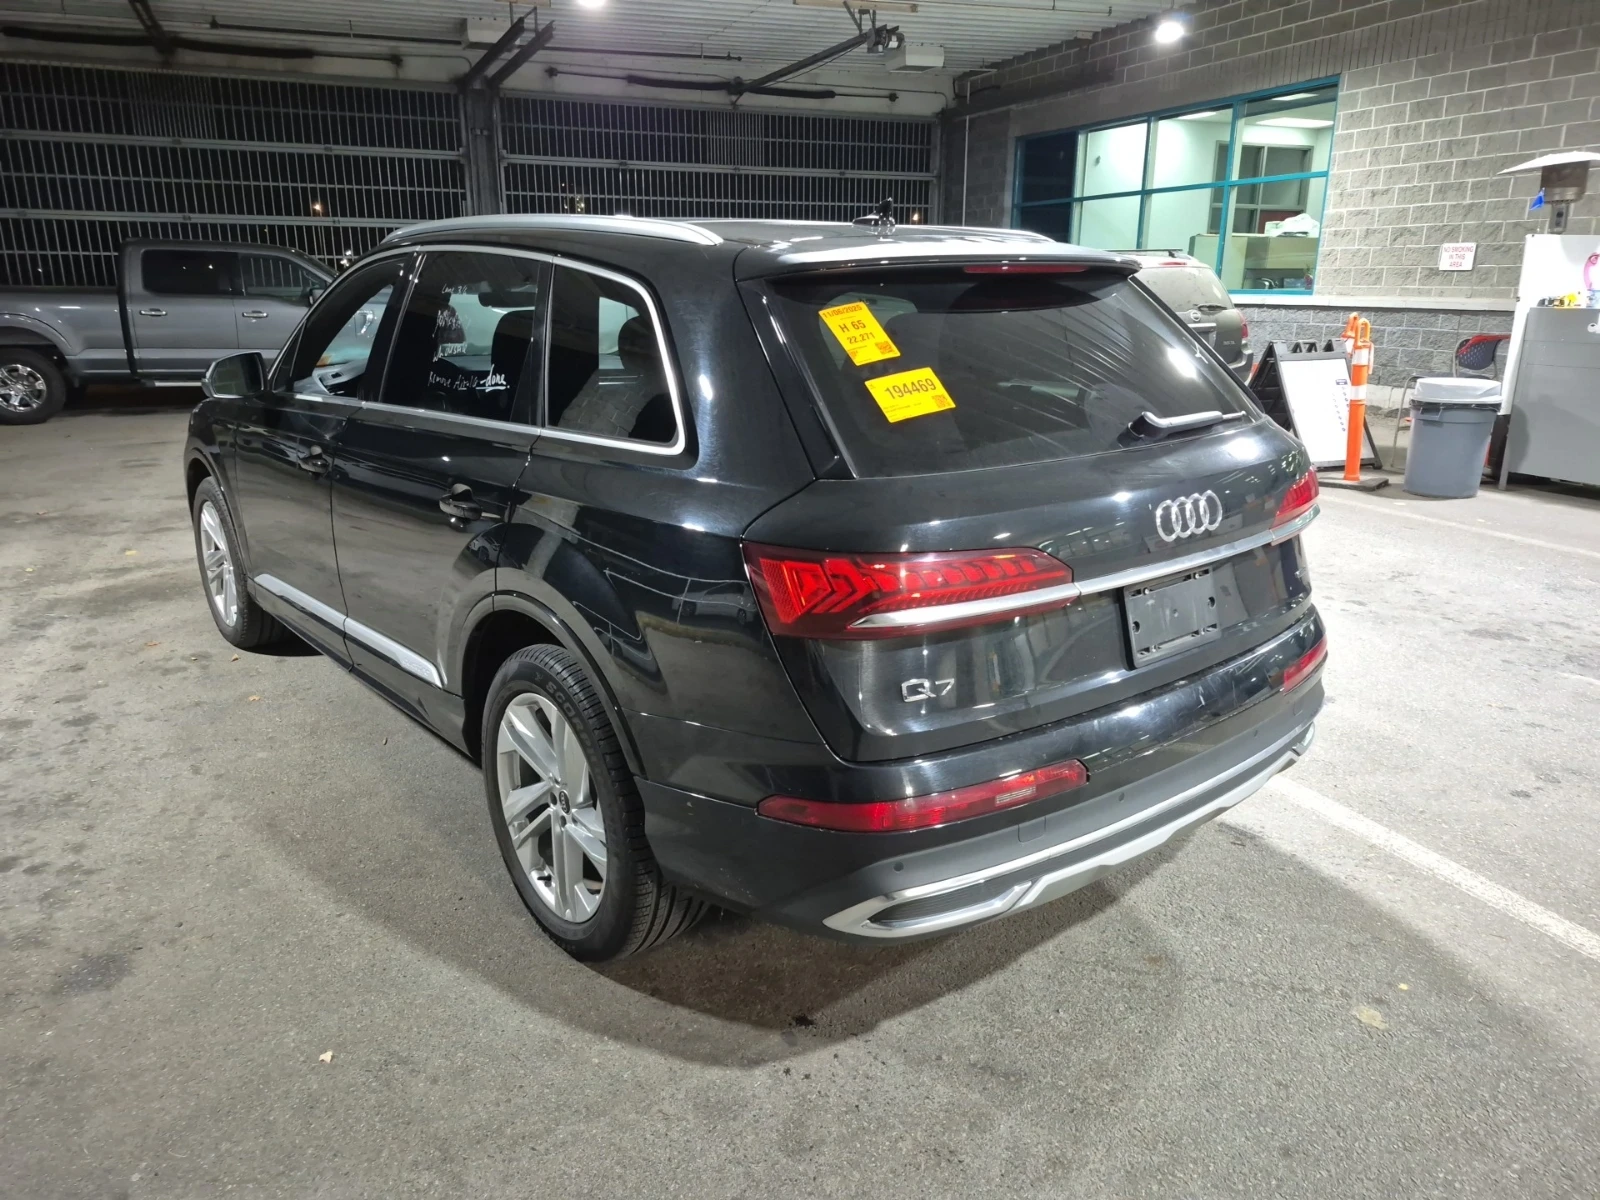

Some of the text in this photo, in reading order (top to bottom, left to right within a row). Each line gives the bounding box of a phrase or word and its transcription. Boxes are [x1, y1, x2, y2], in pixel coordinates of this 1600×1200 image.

[1451, 245, 1474, 253] SMOKING
[838, 319, 867, 333] H 65
[884, 377, 937, 400] 194469
[901, 678, 955, 702] Q7
